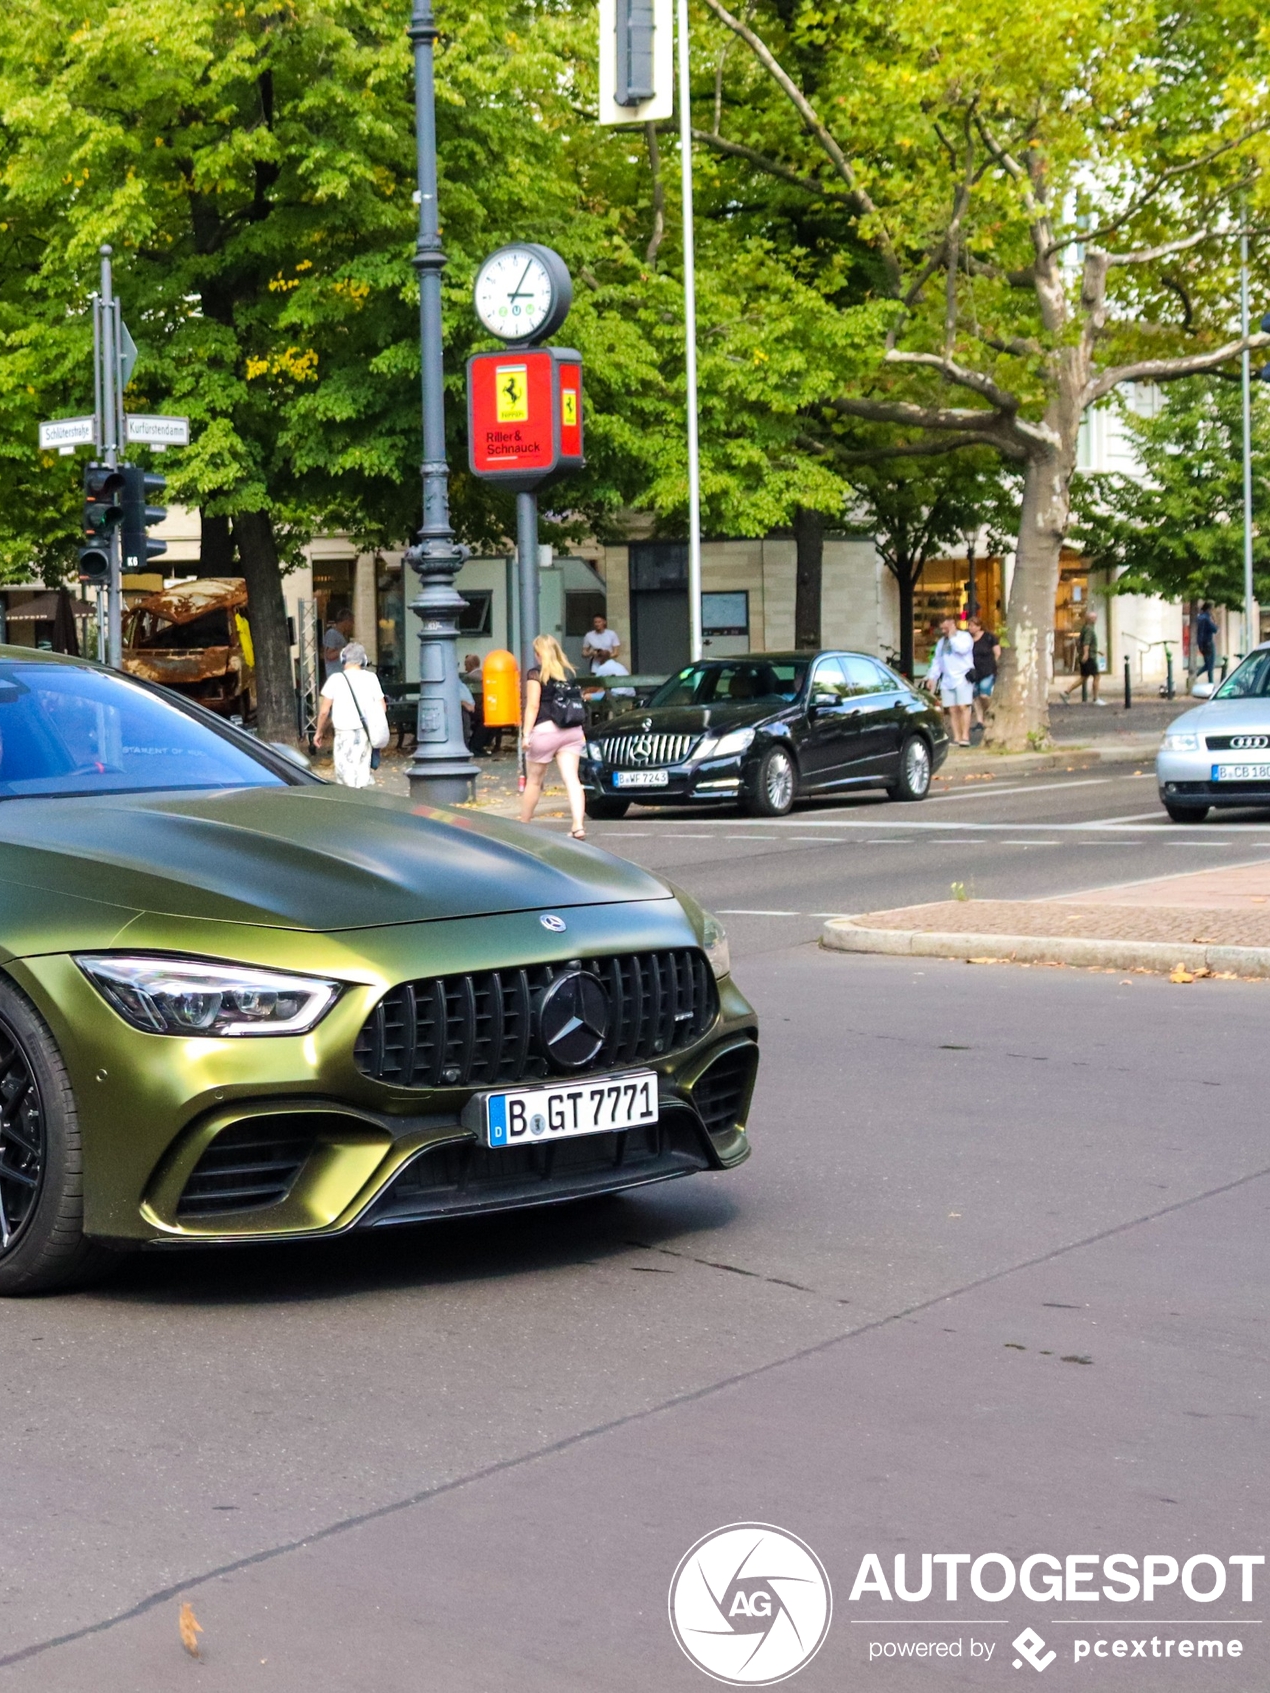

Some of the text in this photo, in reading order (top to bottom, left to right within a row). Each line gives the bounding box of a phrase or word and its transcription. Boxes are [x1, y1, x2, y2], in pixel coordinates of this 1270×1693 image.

[46, 424, 89, 440] Schlüterstraße
[129, 423, 185, 436] Kurfürstendamm
[487, 441, 540, 455] Schnauck
[127, 556, 138, 566] K6
[642, 772, 666, 782] 7243
[1220, 767, 1227, 778] B
[1234, 767, 1249, 777] CB
[494, 1082, 653, 1138] D B GT 7771
